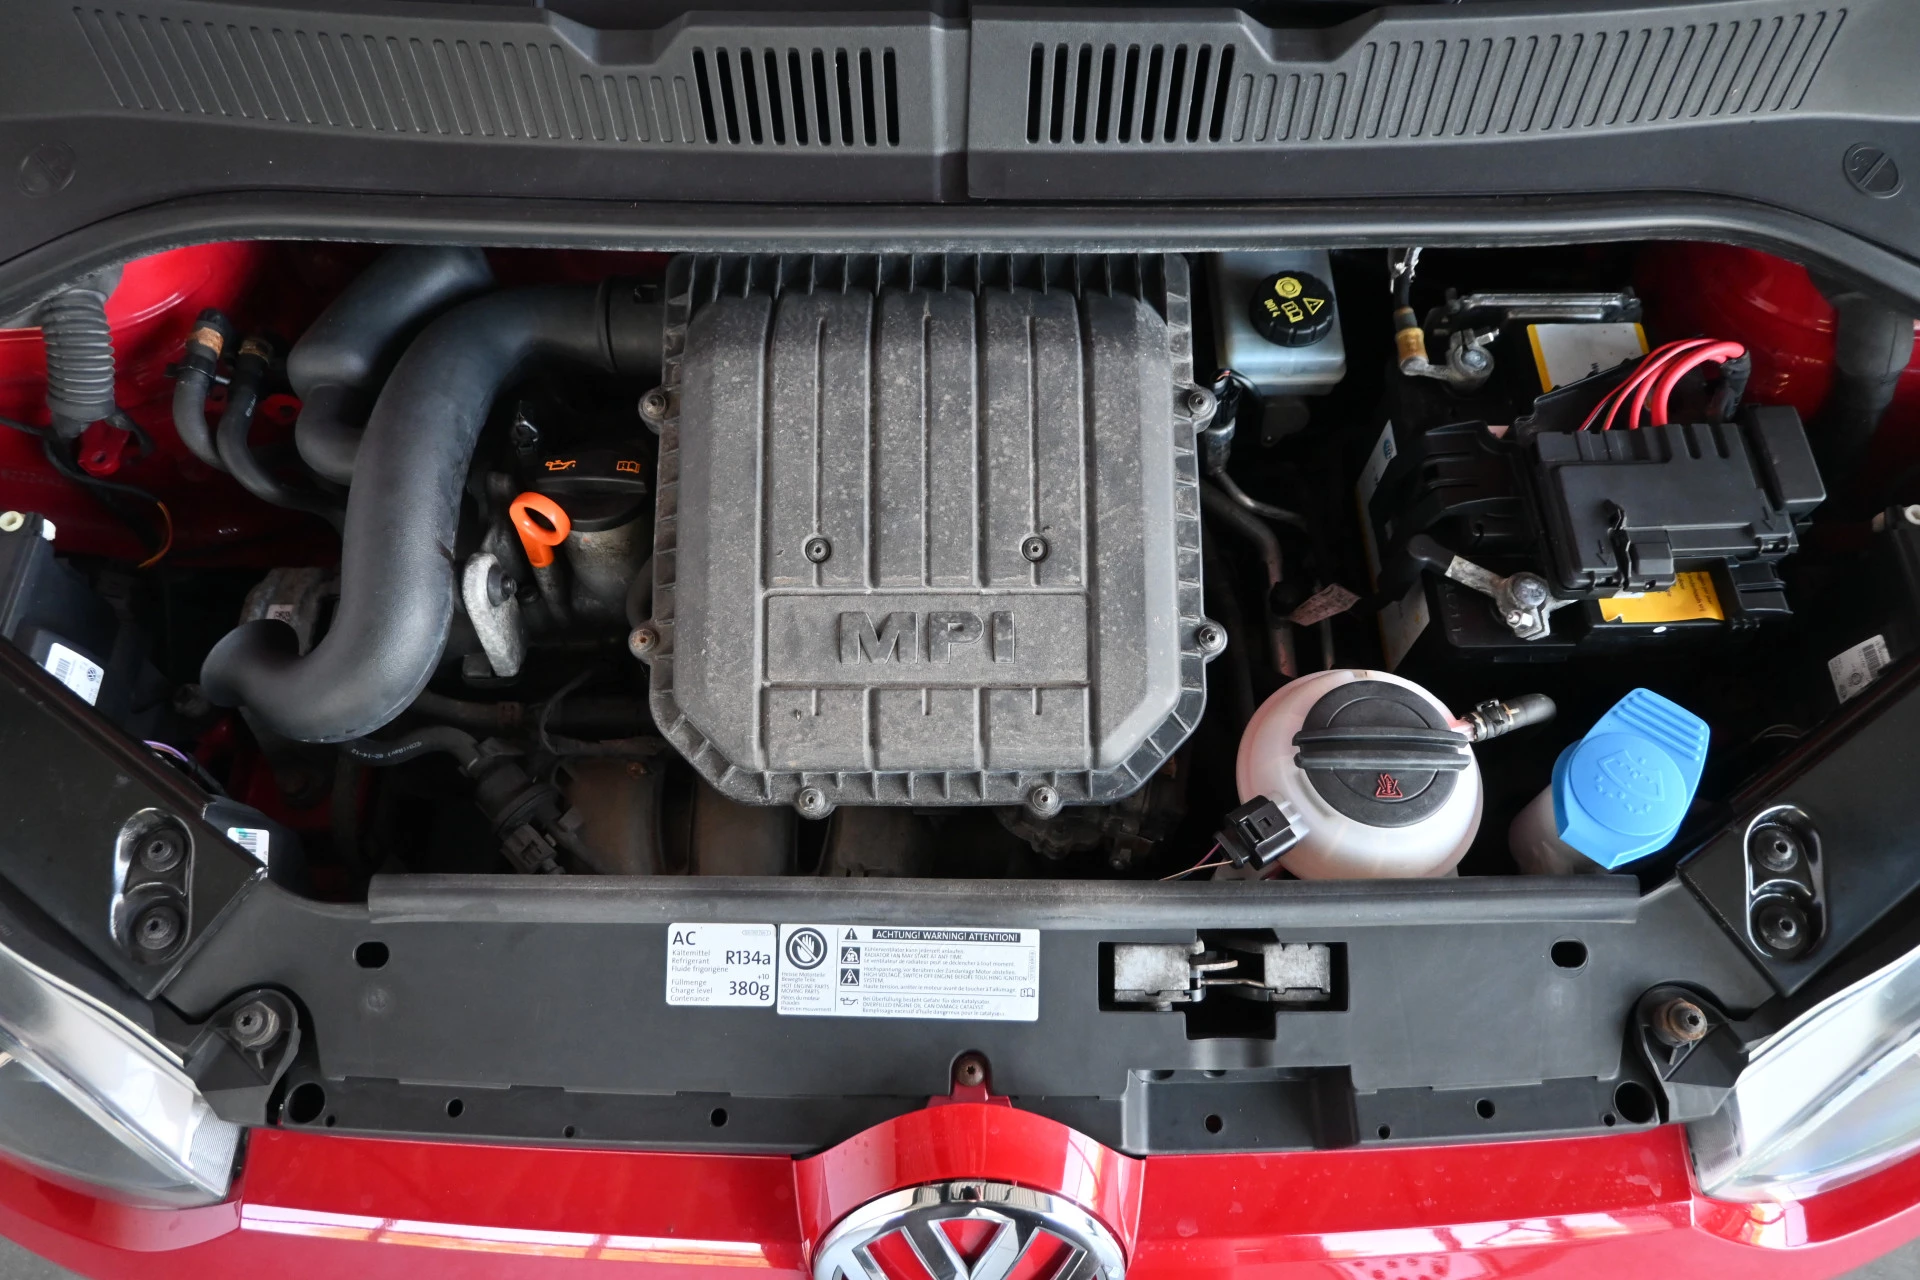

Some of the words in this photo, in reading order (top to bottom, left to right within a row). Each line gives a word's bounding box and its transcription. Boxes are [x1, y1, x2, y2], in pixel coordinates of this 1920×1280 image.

[838, 610, 1016, 666] MPI
[672, 931, 696, 946] AC
[876, 930, 920, 939] ACHTUNG!
[922, 932, 966, 940] WARNING!
[968, 932, 1018, 941] ATTENTION!
[726, 950, 771, 965] R134a
[671, 987, 696, 996] Charge
[729, 980, 770, 1001] 380g
